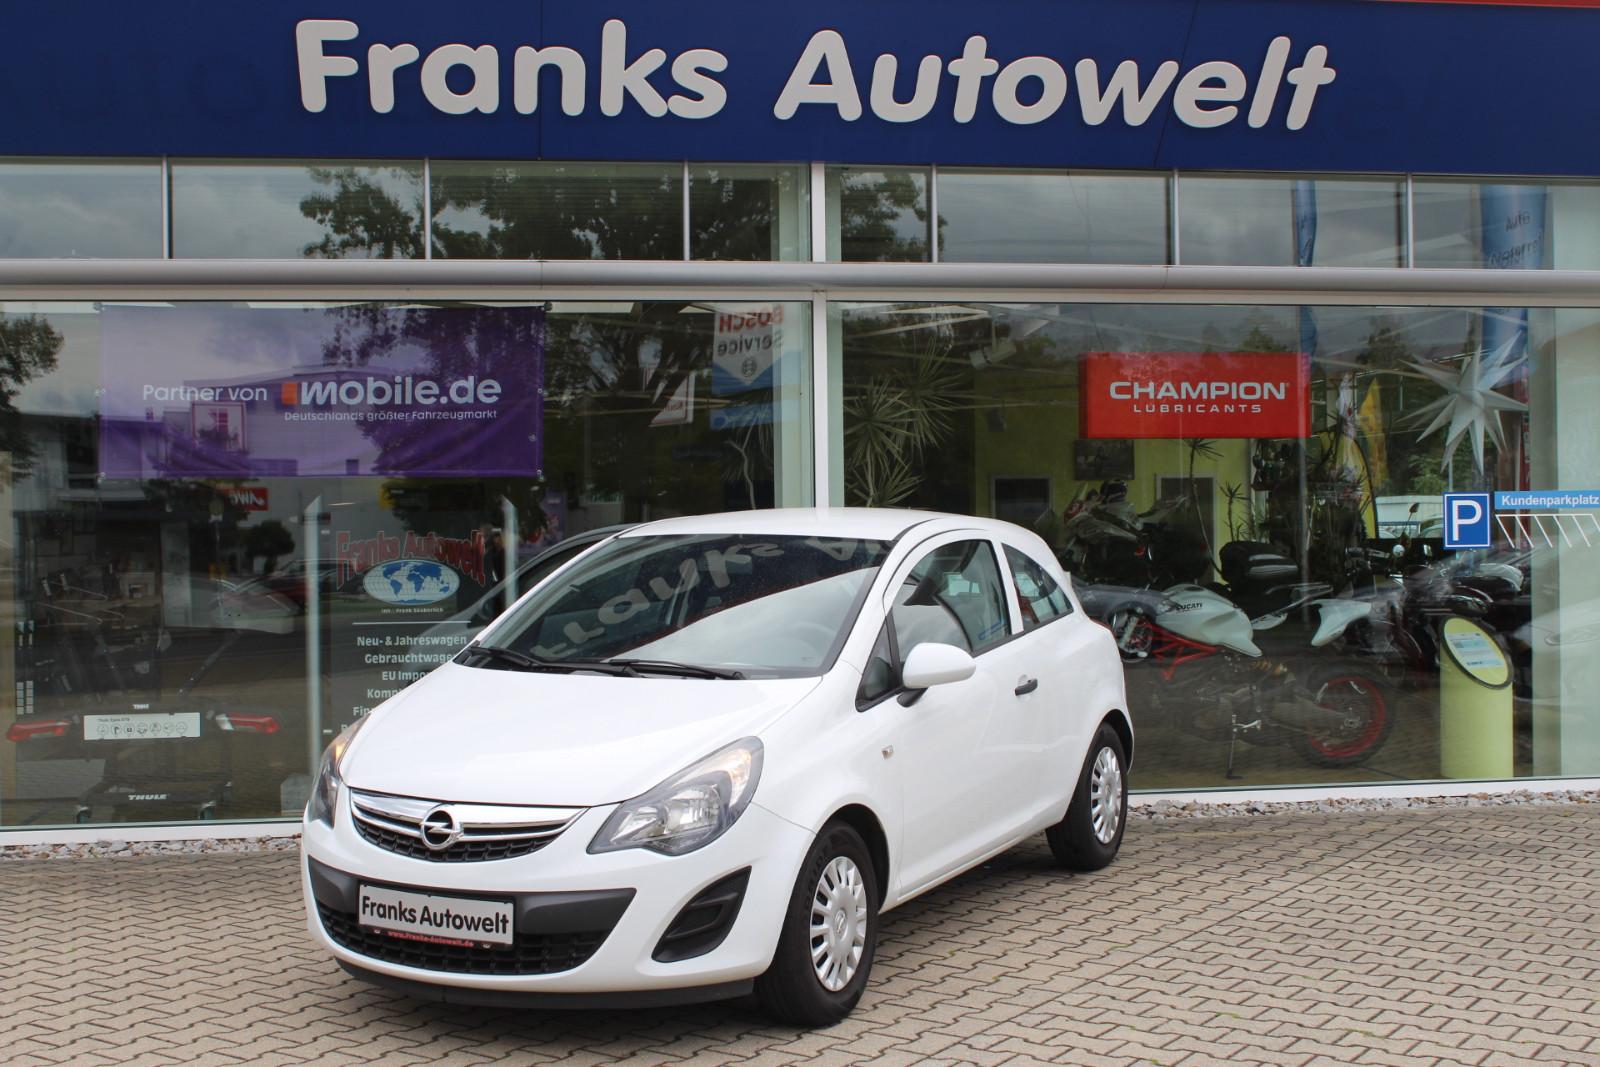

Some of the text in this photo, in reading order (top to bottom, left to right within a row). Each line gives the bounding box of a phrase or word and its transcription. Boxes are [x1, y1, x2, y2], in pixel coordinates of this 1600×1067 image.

[296, 19, 1336, 131] Franks Autowelt
[143, 376, 502, 406] Partner von mobile.de
[1109, 381, 1286, 400] CHAMPION
[1133, 404, 1262, 413] LUBRICANTS
[284, 410, 498, 423] Deutschlands größter Fahrzeugmarkt
[1501, 494, 1600, 508] Kundenparkplatz
[1452, 499, 1482, 542] P
[356, 635, 467, 647] Neu- & Jahreswagen
[382, 671, 396, 680] EU
[128, 793, 168, 801] THULE
[362, 895, 510, 934] Franks Autowelt
